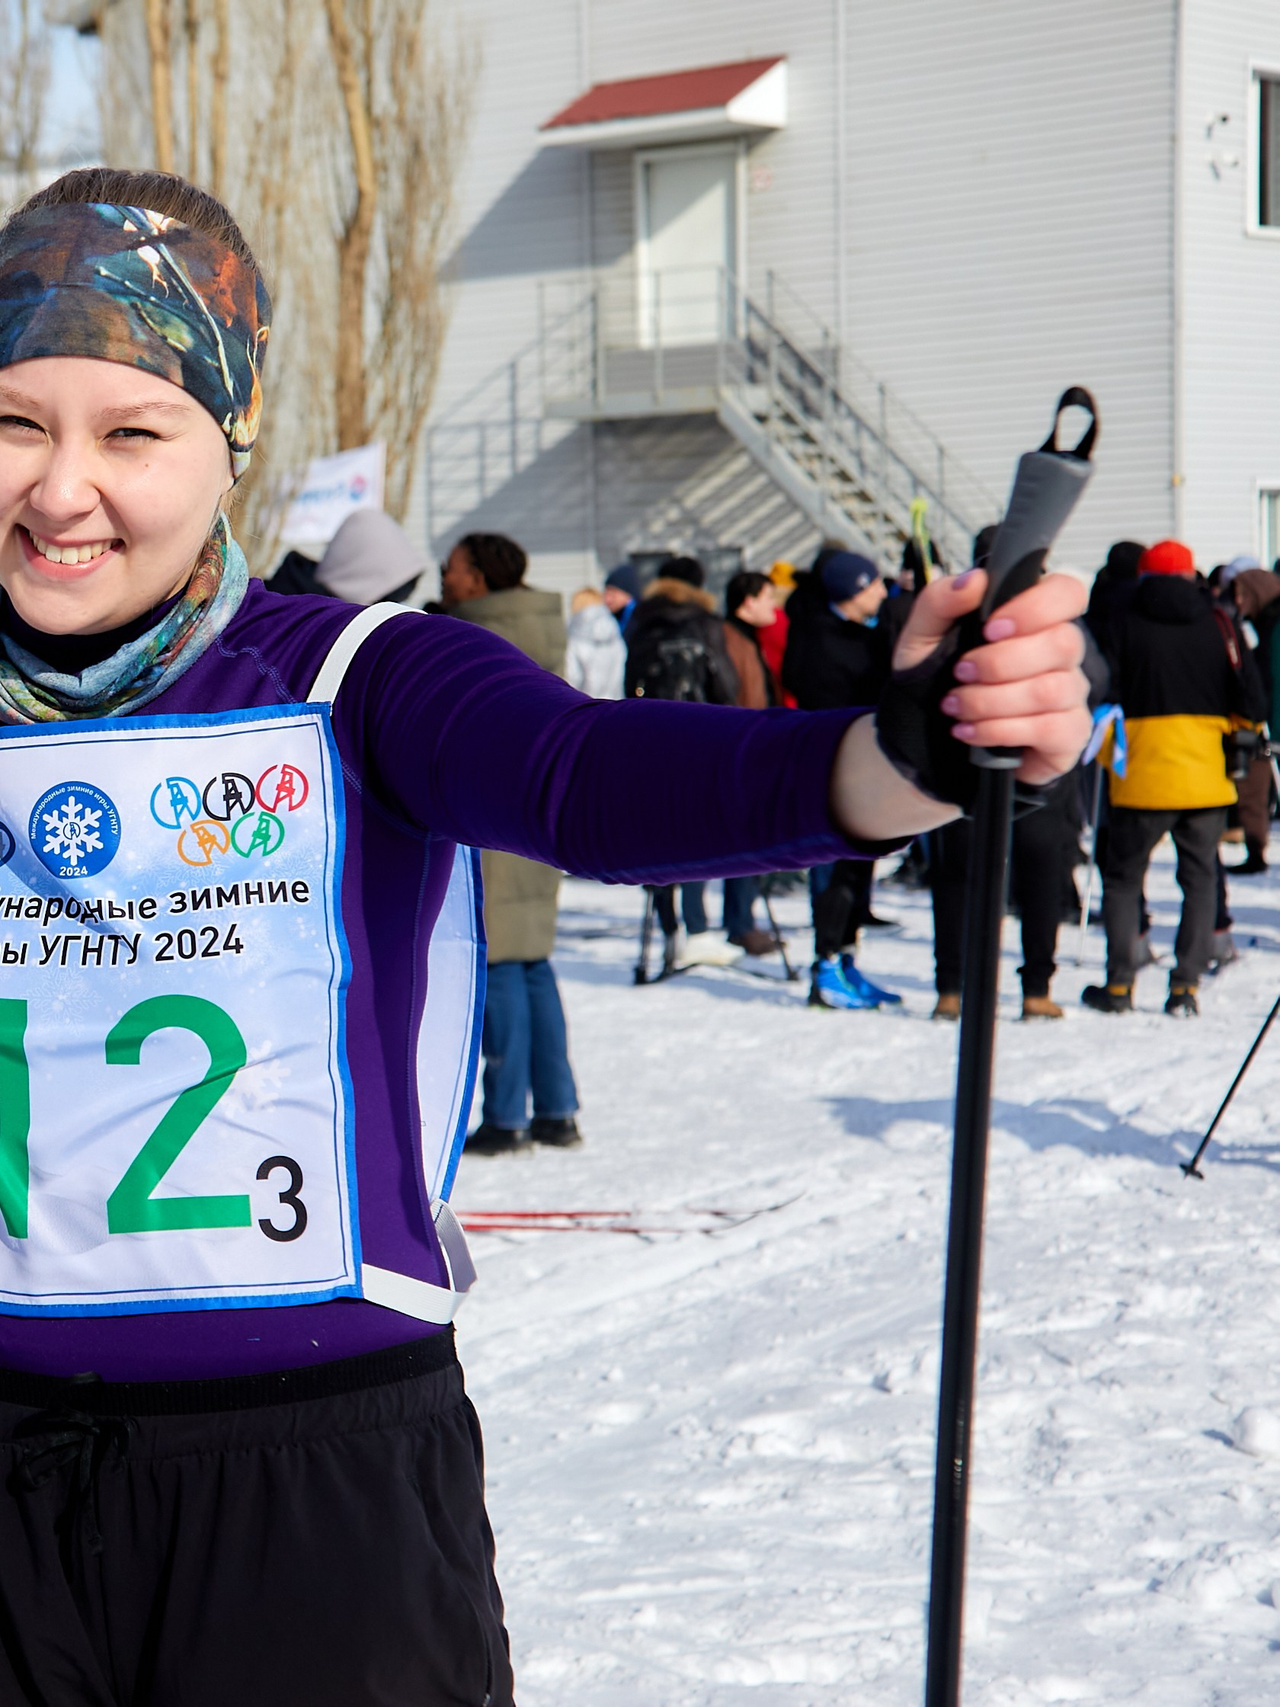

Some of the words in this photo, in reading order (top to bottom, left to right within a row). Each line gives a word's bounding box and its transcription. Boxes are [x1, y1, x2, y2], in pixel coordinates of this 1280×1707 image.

[31, 788, 65, 839] Международные
[67, 786, 94, 795] зимние
[94, 792, 110, 810] игры
[107, 809, 118, 835] УГНТУ
[59, 865, 88, 877] 2024
[169, 880, 310, 913] зимние
[38, 933, 142, 966] УГНТУ
[154, 923, 244, 962] 2024
[256, 1155, 308, 1242] 3
